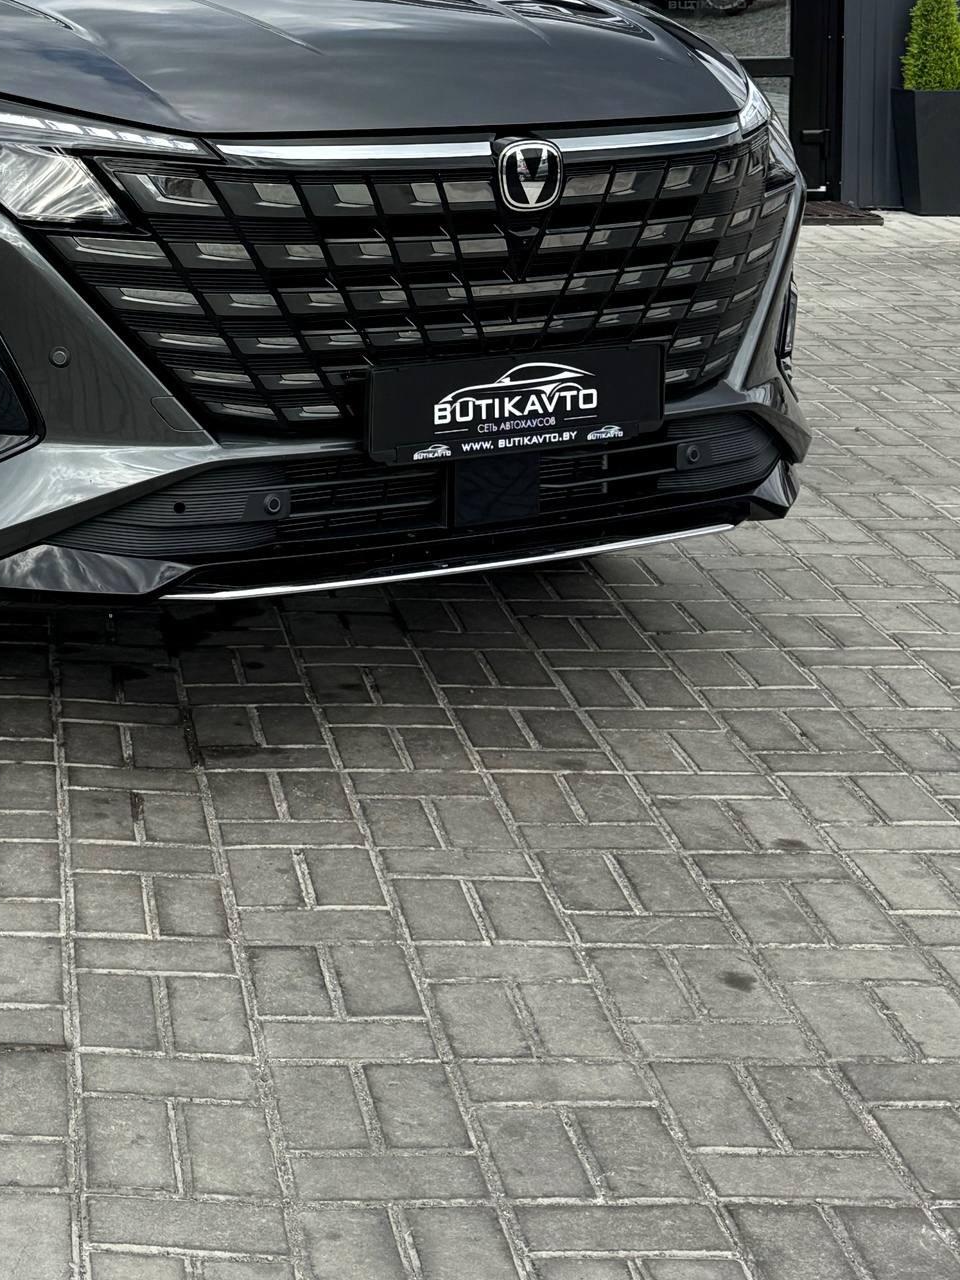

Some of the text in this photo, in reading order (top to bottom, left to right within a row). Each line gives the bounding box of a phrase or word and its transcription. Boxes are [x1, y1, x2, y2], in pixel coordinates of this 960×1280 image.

[433, 388, 598, 426] BUTIKAVTO
[477, 416, 556, 433] СЕТЬ АВТОХАУСОВ
[461, 430, 578, 452] WWW. BUTIKAVTO.BY
